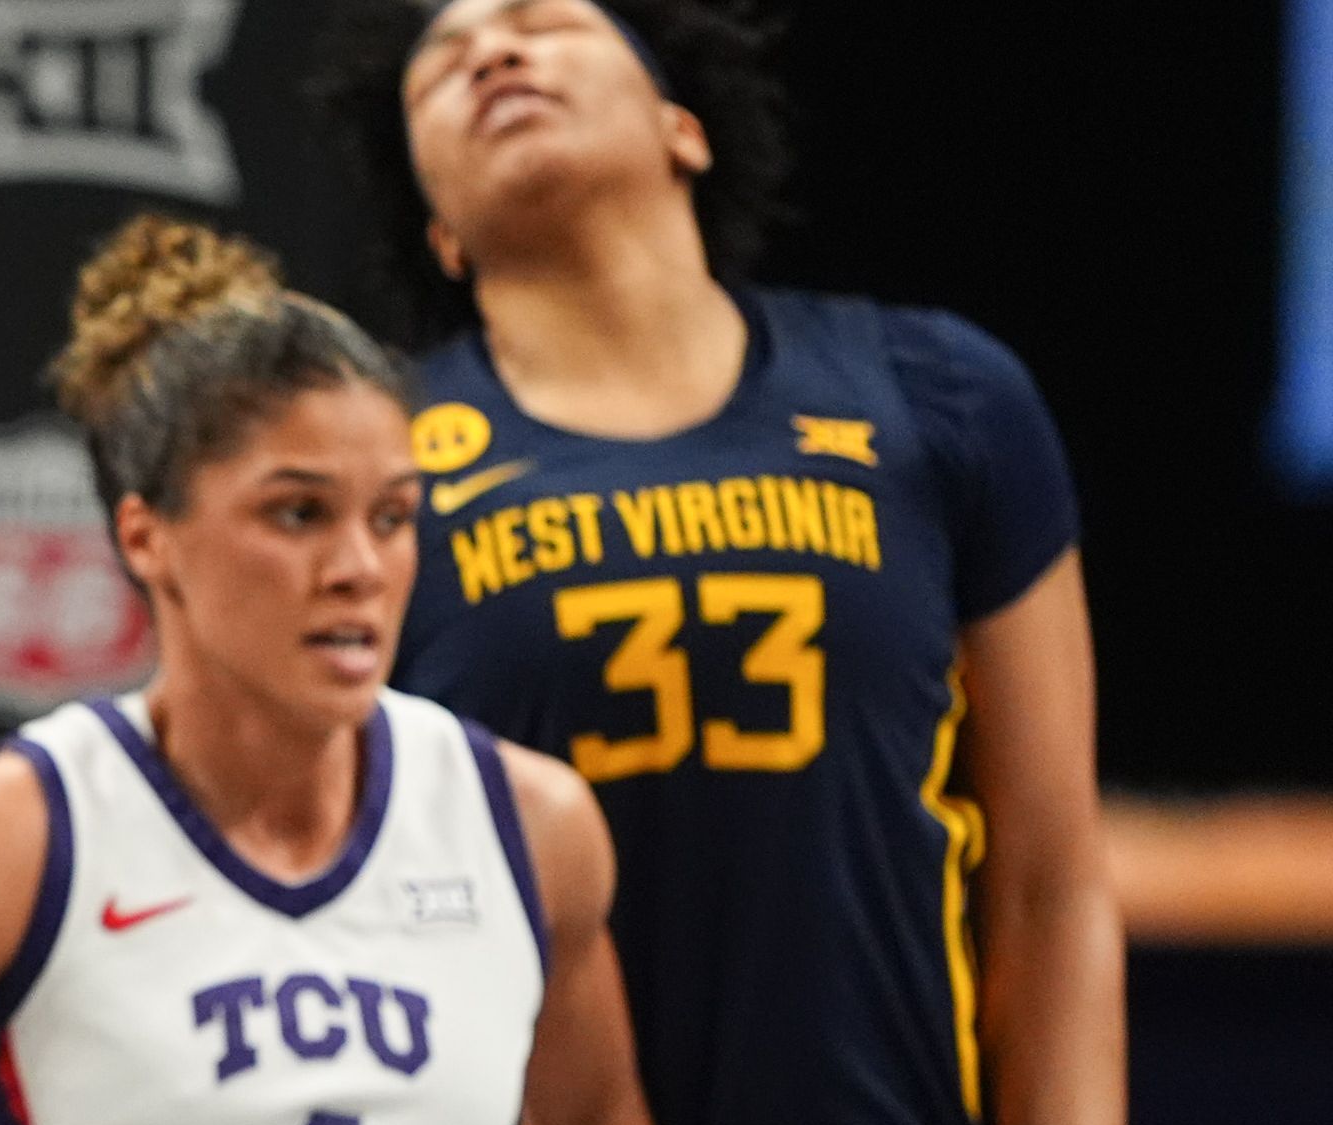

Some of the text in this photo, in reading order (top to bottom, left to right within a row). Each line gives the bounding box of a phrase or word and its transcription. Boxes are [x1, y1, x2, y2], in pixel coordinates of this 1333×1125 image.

[452, 475, 881, 602] WEST VIRGINIA
[553, 574, 825, 782] 33
[192, 974, 430, 1082] TCU
